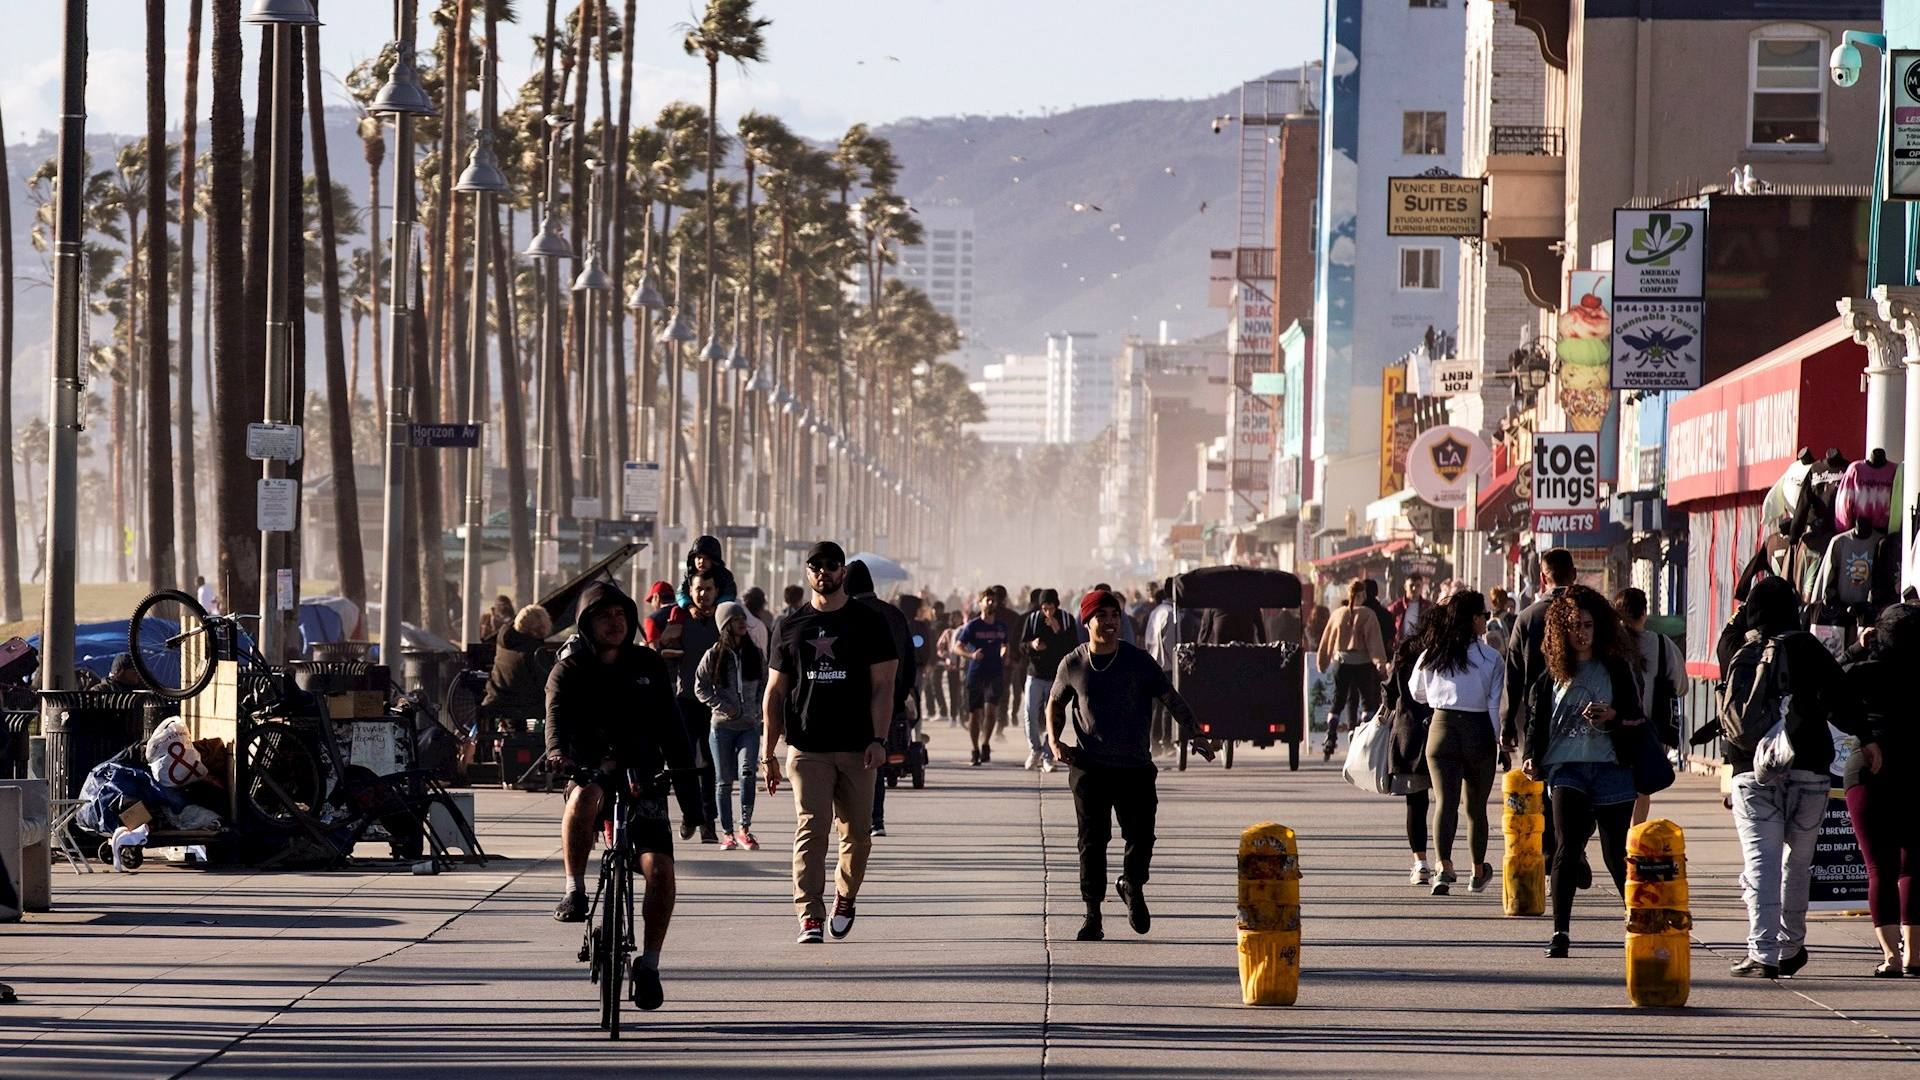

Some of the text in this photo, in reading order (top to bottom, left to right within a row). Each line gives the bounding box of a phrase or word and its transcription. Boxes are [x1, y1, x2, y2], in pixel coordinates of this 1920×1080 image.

[1905, 115, 1920, 123] LES
[1394, 183, 1479, 193] VENICE BEACH
[1404, 195, 1467, 212] SUITES
[1640, 286, 1677, 294] COMPANY
[1245, 305, 1272, 318] BEAC
[1616, 304, 1699, 313] 844-933-3289
[1441, 371, 1473, 381] RENT
[1445, 382, 1468, 391] FOR
[413, 425, 475, 437] Horizon Av
[1439, 451, 1461, 465] LA
[1535, 437, 1595, 475] toe
[1537, 477, 1595, 506] rings
[1537, 514, 1594, 532] ANKLETS
[806, 671, 846, 679] LOS ANGELES
[1816, 843, 1833, 852] ICED
[1834, 842, 1857, 851] DRAFT
[1827, 864, 1868, 876] COLOM
